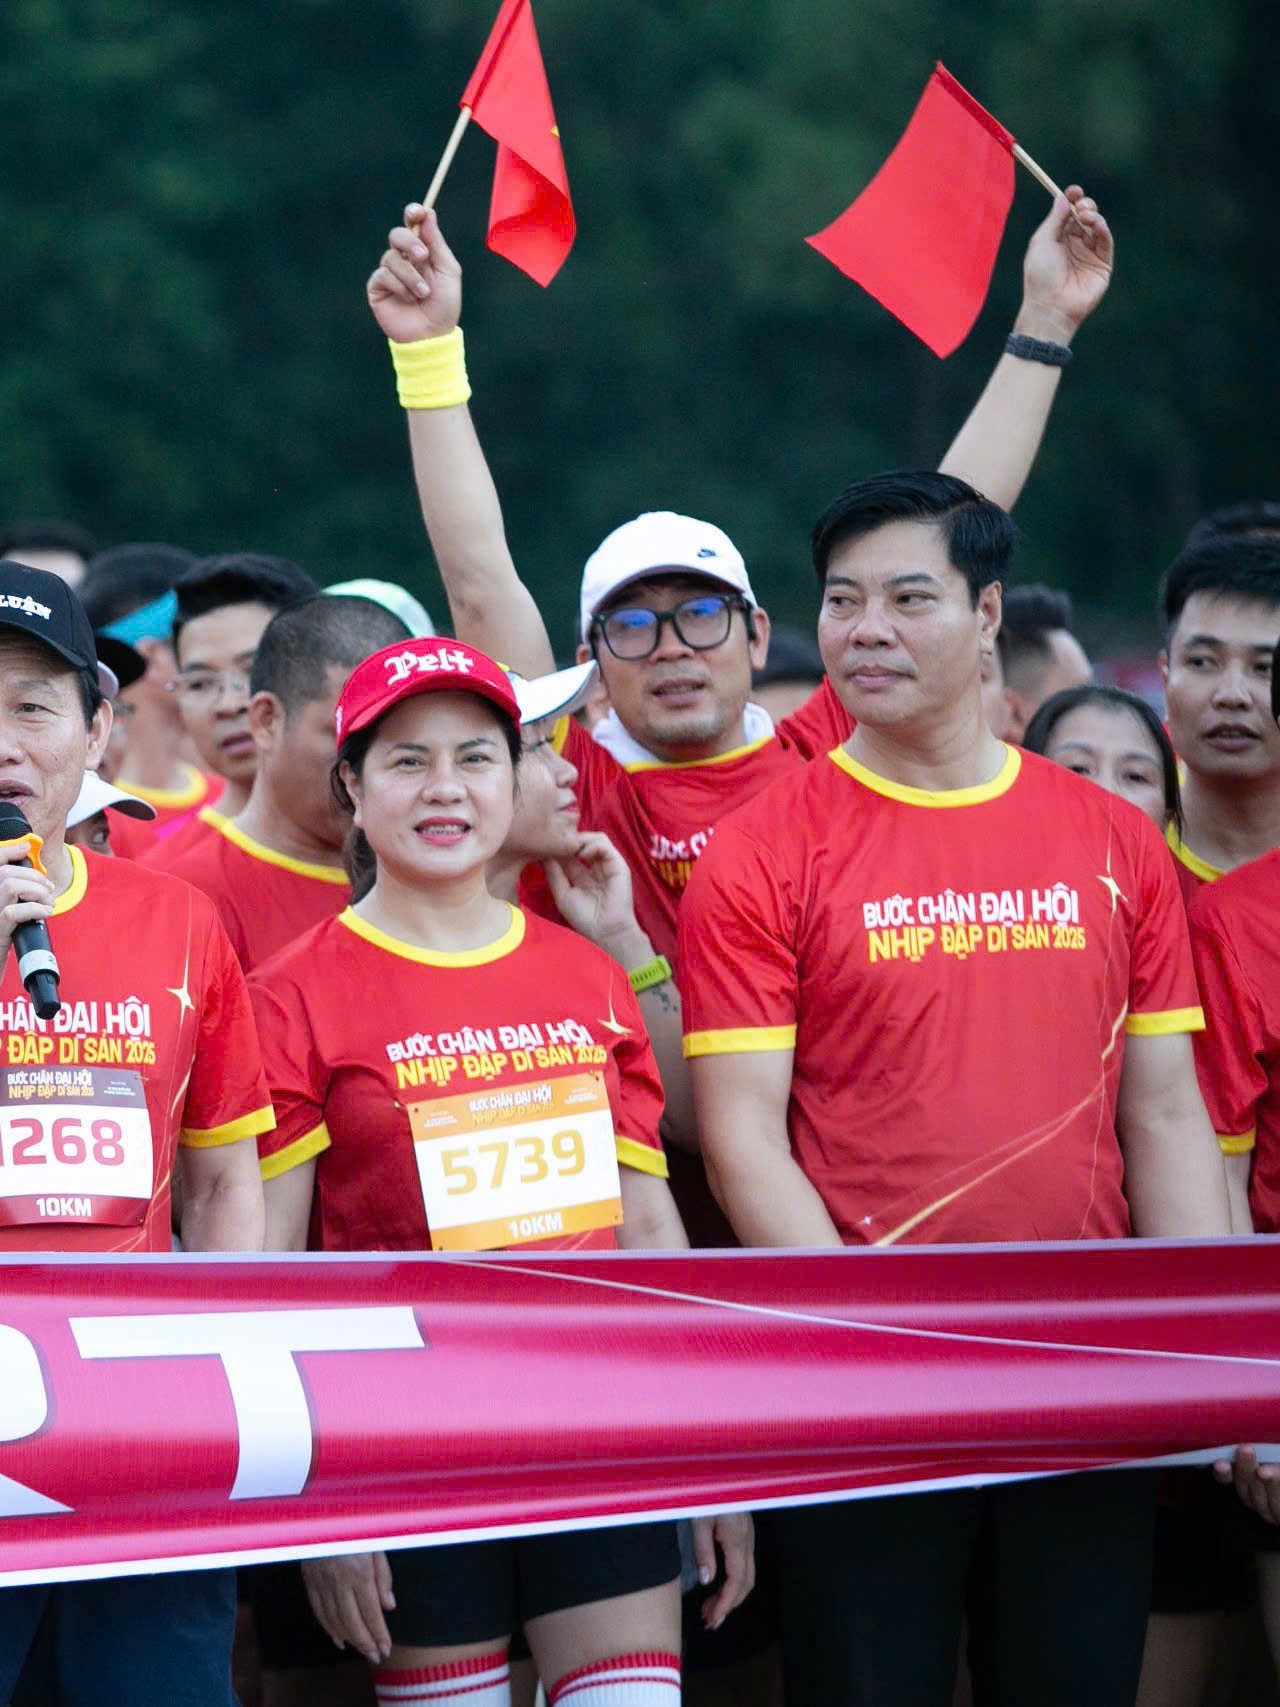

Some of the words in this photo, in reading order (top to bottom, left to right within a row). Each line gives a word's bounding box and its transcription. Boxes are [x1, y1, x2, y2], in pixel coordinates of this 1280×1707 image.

[384, 647, 474, 686] Pelt
[863, 893, 915, 929] BƯỚC
[918, 888, 976, 925] CHÂN
[979, 890, 1024, 928] ĐẠI
[1031, 881, 1079, 929] HỘI
[869, 927, 935, 963] NHỊP
[941, 921, 984, 960] ĐẬP
[1012, 915, 1050, 950] SẢN
[1052, 927, 1087, 950] 2025
[53, 1001, 99, 1039] ĐẠI
[104, 995, 151, 1040] HỘI
[59, 1036, 79, 1064] DI
[84, 1029, 122, 1063] SẢN
[125, 1041, 156, 1065] 2025
[386, 1031, 437, 1062] BƯỚC
[437, 1026, 497, 1056] CHÂN
[498, 1023, 545, 1052] ĐẠI
[545, 1018, 595, 1047] HỘI
[395, 1055, 458, 1089] NHỊP
[462, 1049, 508, 1081] ĐẬP
[535, 1040, 574, 1068] SẢN
[573, 1044, 608, 1065] 2025
[441, 1129, 586, 1196] 5739
[36, 1197, 92, 1217] 10KM
[509, 1211, 564, 1239] 10KM
